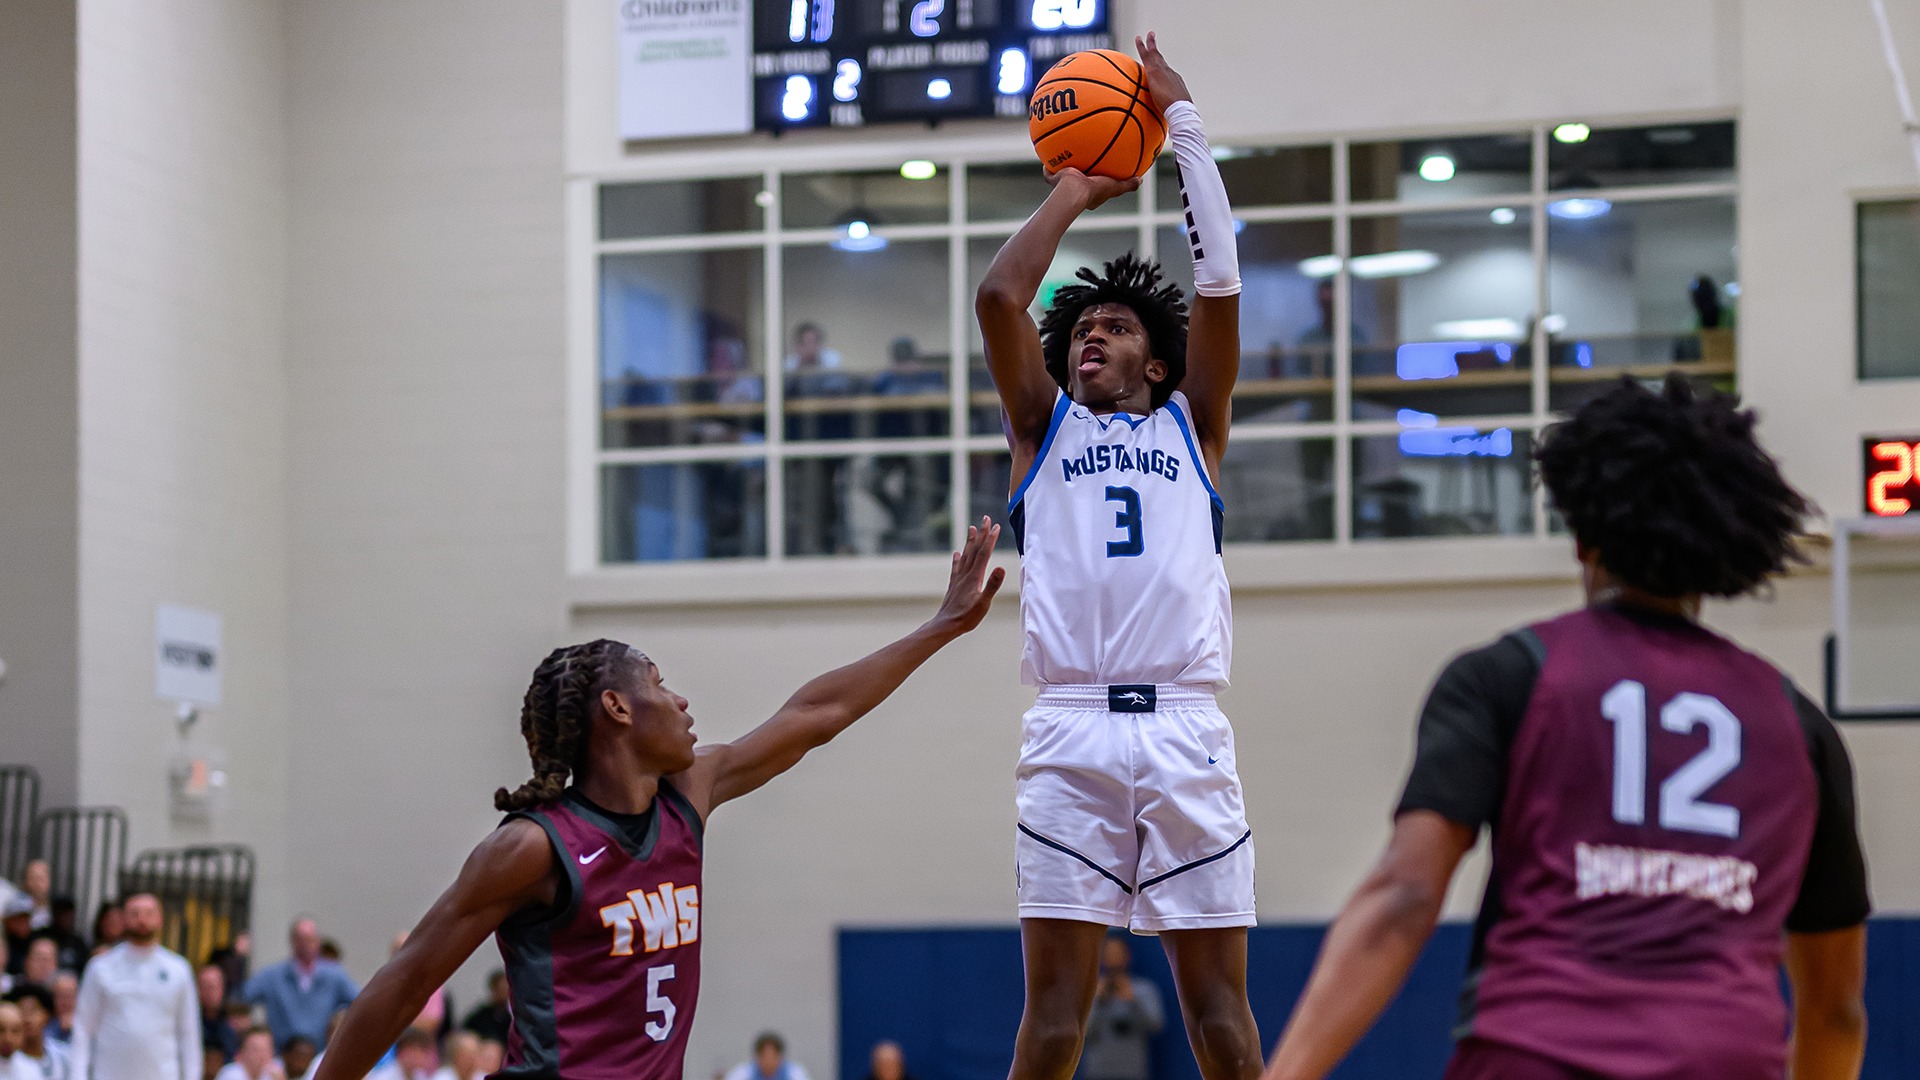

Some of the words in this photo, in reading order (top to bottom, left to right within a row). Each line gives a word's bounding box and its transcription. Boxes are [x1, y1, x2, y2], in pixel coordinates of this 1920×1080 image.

[833, 59, 861, 101] 2
[1029, 88, 1079, 121] Wils
[1061, 443, 1181, 483] MUSTANGS
[1866, 442, 1920, 517] 2
[1104, 485, 1145, 559] 3
[1600, 679, 1743, 839] 12
[599, 881, 699, 957] TWS
[644, 963, 677, 1042] 5
